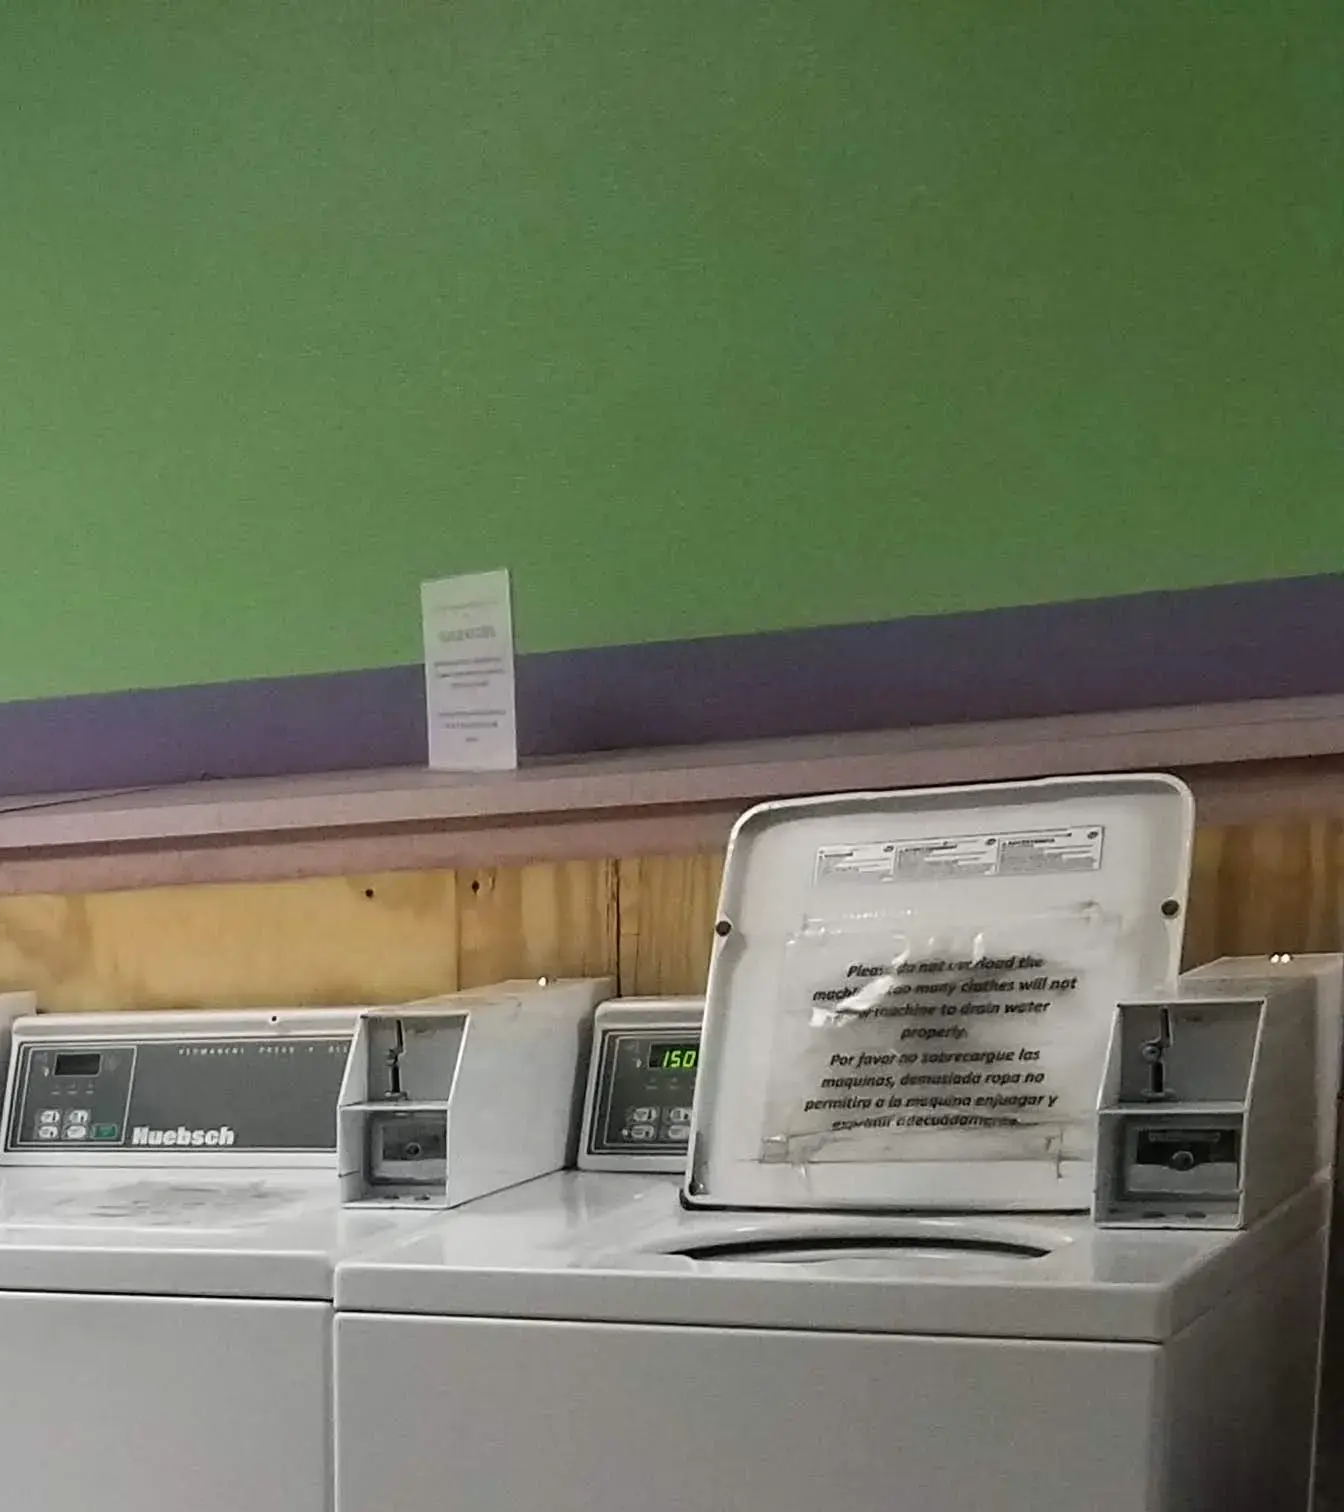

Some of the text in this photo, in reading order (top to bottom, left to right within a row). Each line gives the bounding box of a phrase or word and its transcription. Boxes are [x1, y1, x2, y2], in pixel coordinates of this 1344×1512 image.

[847, 963, 892, 978] Pleas
[915, 984, 956, 998] many
[961, 978, 1015, 993] clothes
[1018, 977, 1048, 991] will
[1049, 977, 1078, 990] not
[941, 1003, 957, 1016] to
[960, 1000, 1000, 1016] drain
[1004, 1000, 1051, 1014] water
[830, 1053, 854, 1067] Por
[855, 1052, 897, 1069] favor
[920, 1049, 1015, 1066] sobrecargue
[1018, 1048, 1041, 1061] las
[984, 1073, 1020, 1087] ropa
[1024, 1072, 1045, 1084] no
[804, 1095, 872, 1112] permitira
[874, 1098, 885, 1109] a
[1046, 1093, 1059, 1107] y
[131, 1126, 235, 1146] Huebsch
